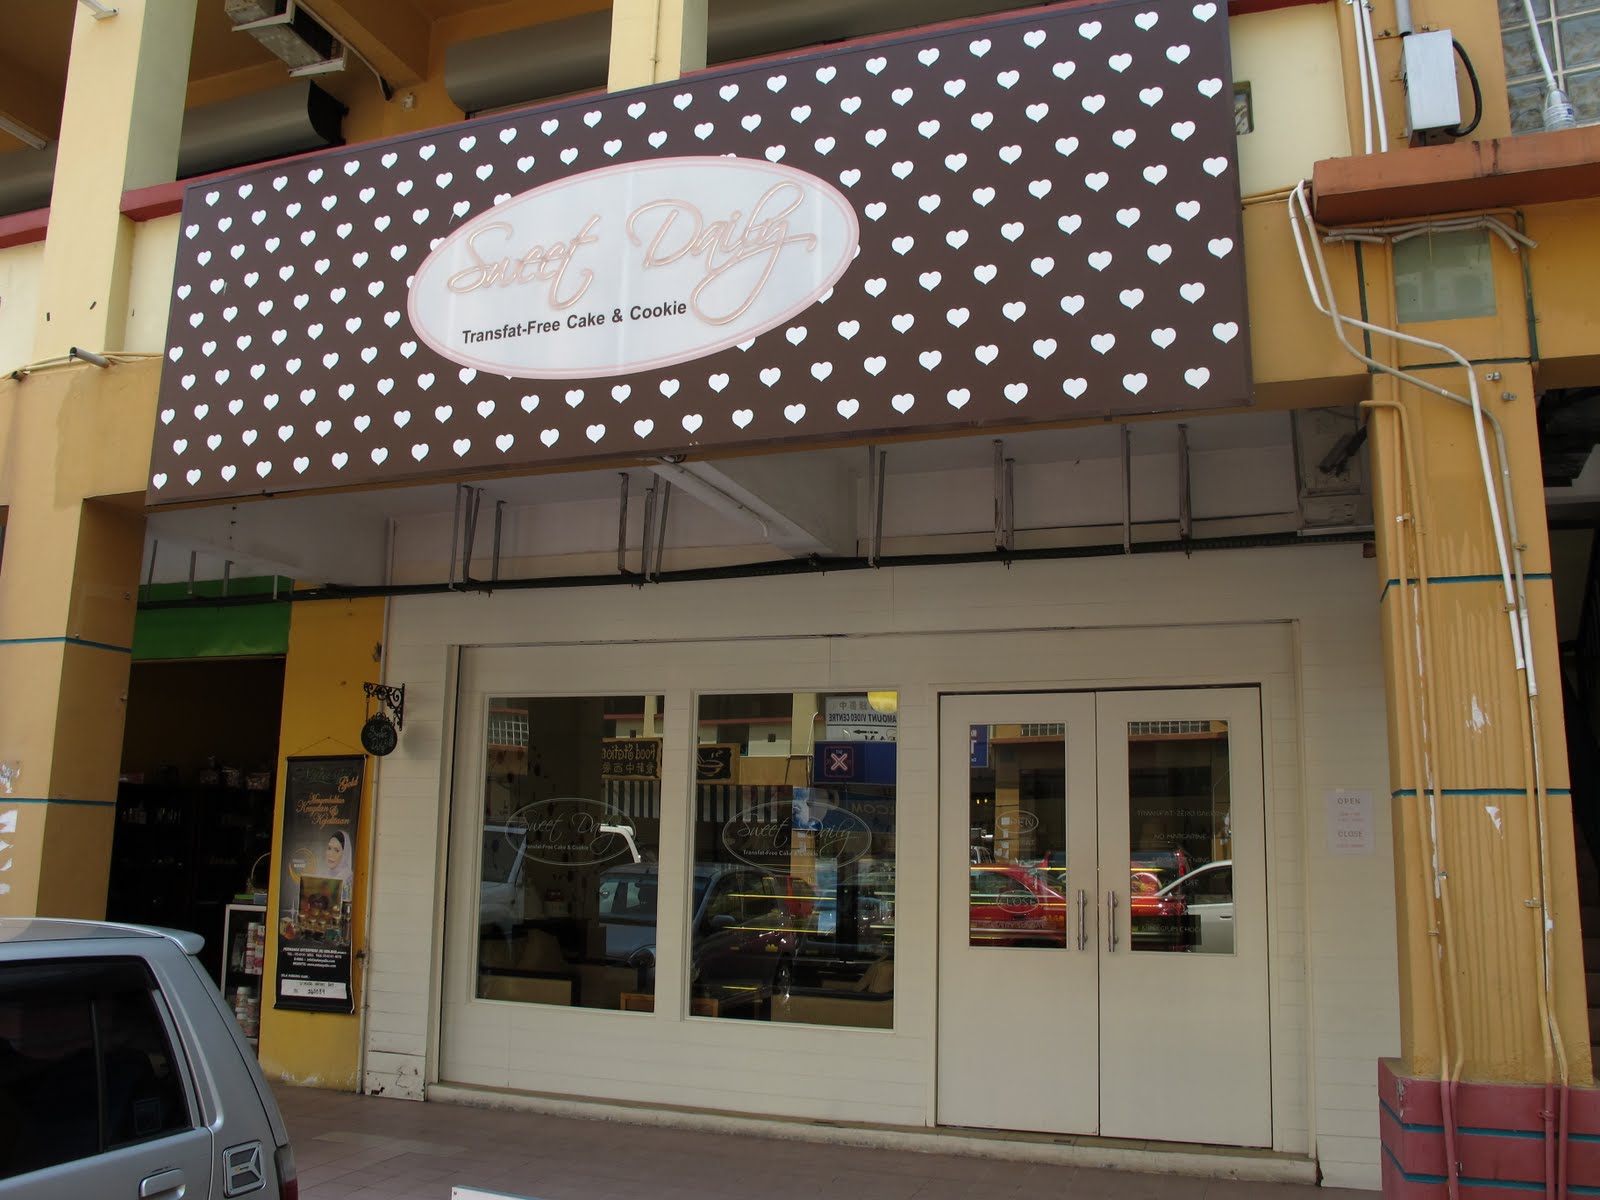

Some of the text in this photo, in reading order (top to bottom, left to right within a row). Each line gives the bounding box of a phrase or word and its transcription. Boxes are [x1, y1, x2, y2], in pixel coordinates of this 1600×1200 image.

[446, 181, 818, 326] Sweet Daily
[462, 301, 687, 344] Transfat-Free Cake & Cookie
[1337, 797, 1361, 805] OPEN
[519, 810, 565, 843] Sweet
[736, 811, 859, 860] Sweet Daily
[1001, 817, 1034, 827] PEN
[1337, 830, 1364, 838] CLOSE
